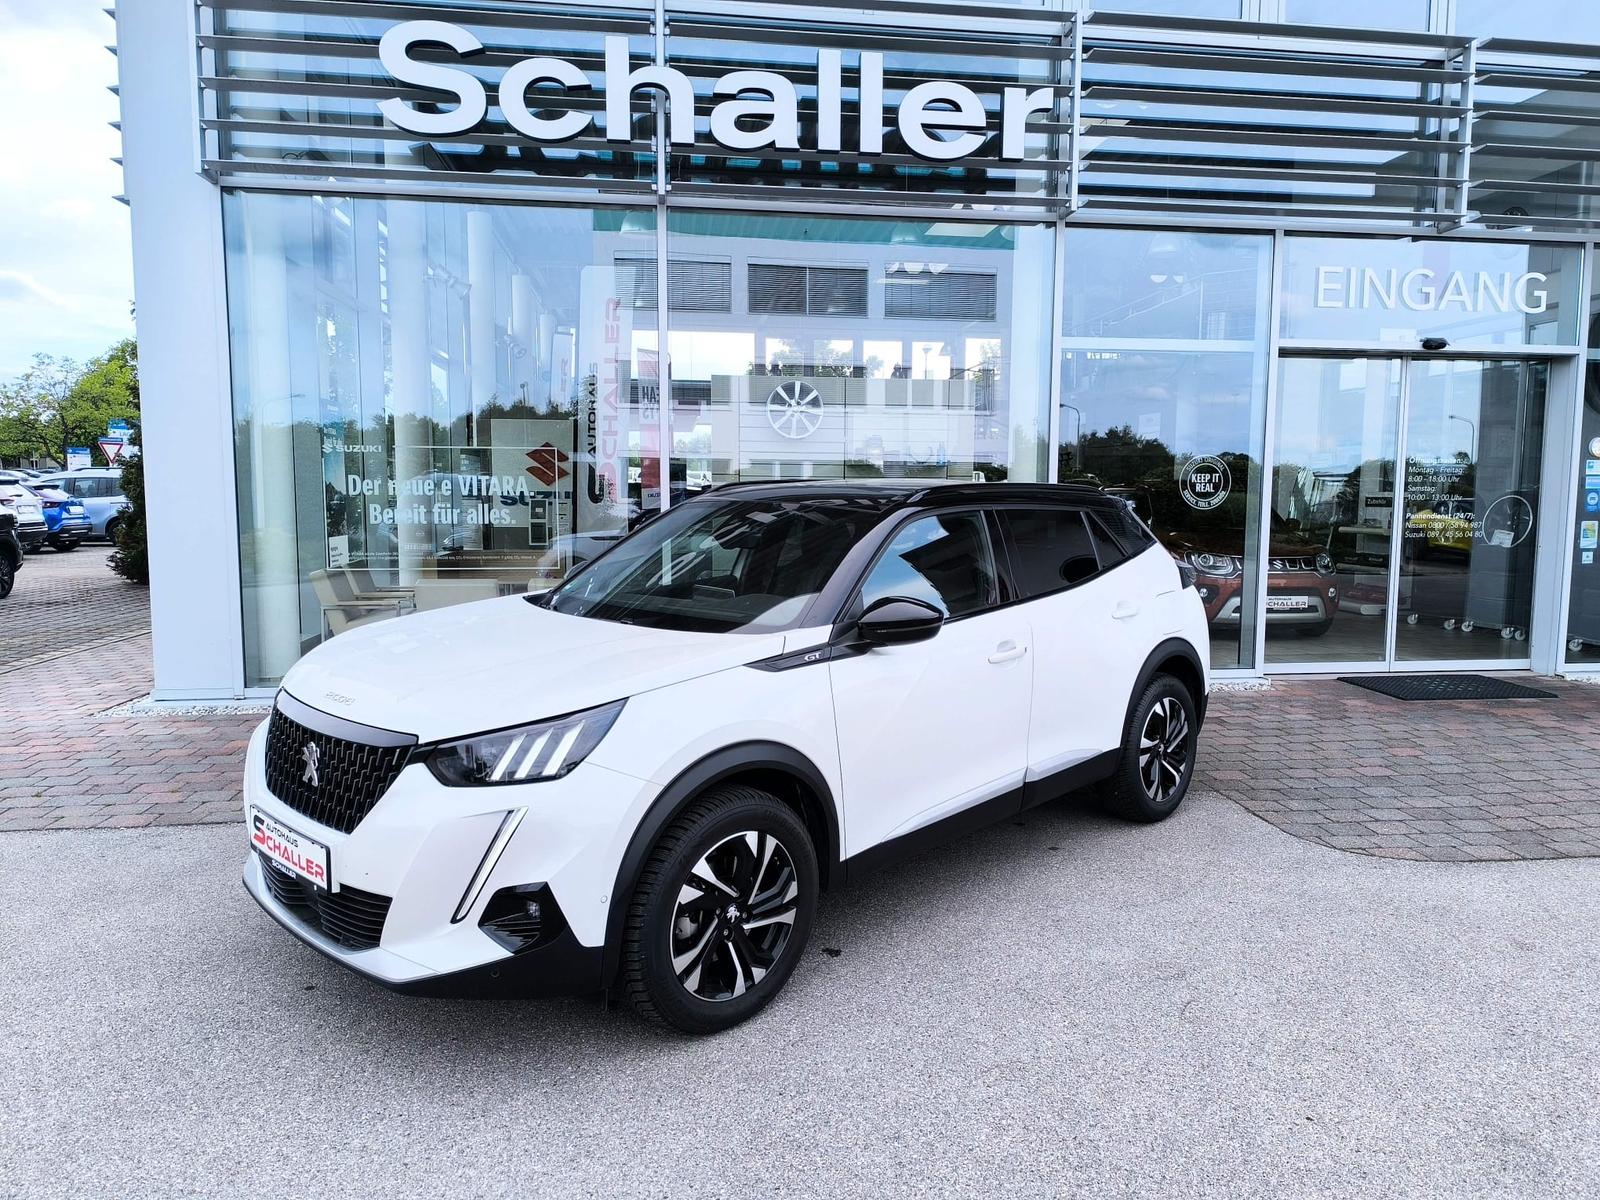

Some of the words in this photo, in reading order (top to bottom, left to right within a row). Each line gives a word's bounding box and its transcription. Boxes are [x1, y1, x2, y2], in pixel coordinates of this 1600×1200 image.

[376, 19, 1054, 161] Schaller
[1315, 265, 1548, 314] EINGANG
[587, 362, 598, 459] AUTOHAUS
[334, 444, 382, 453] SUZUKI
[1408, 466, 1434, 475] Montag
[1440, 466, 1465, 475] Freitag:
[1191, 473, 1211, 483] KEEP
[1212, 473, 1220, 483] IT
[348, 475, 381, 496] Der
[388, 478, 435, 496] neue
[441, 479, 452, 496] e
[458, 475, 535, 496] VITARA.
[1195, 483, 1215, 493] REAL
[1408, 485, 1437, 493] Samstag:
[369, 503, 428, 525] Bereit
[433, 503, 460, 525] für
[467, 503, 517, 525] alles.
[1405, 521, 1427, 529] Nissan
[1405, 530, 1426, 538] Suzuki
[1426, 530, 1439, 538] 089
[804, 651, 821, 662] GT
[266, 823, 298, 848] AUTOHAUS
[253, 814, 325, 882] SCHALLER
